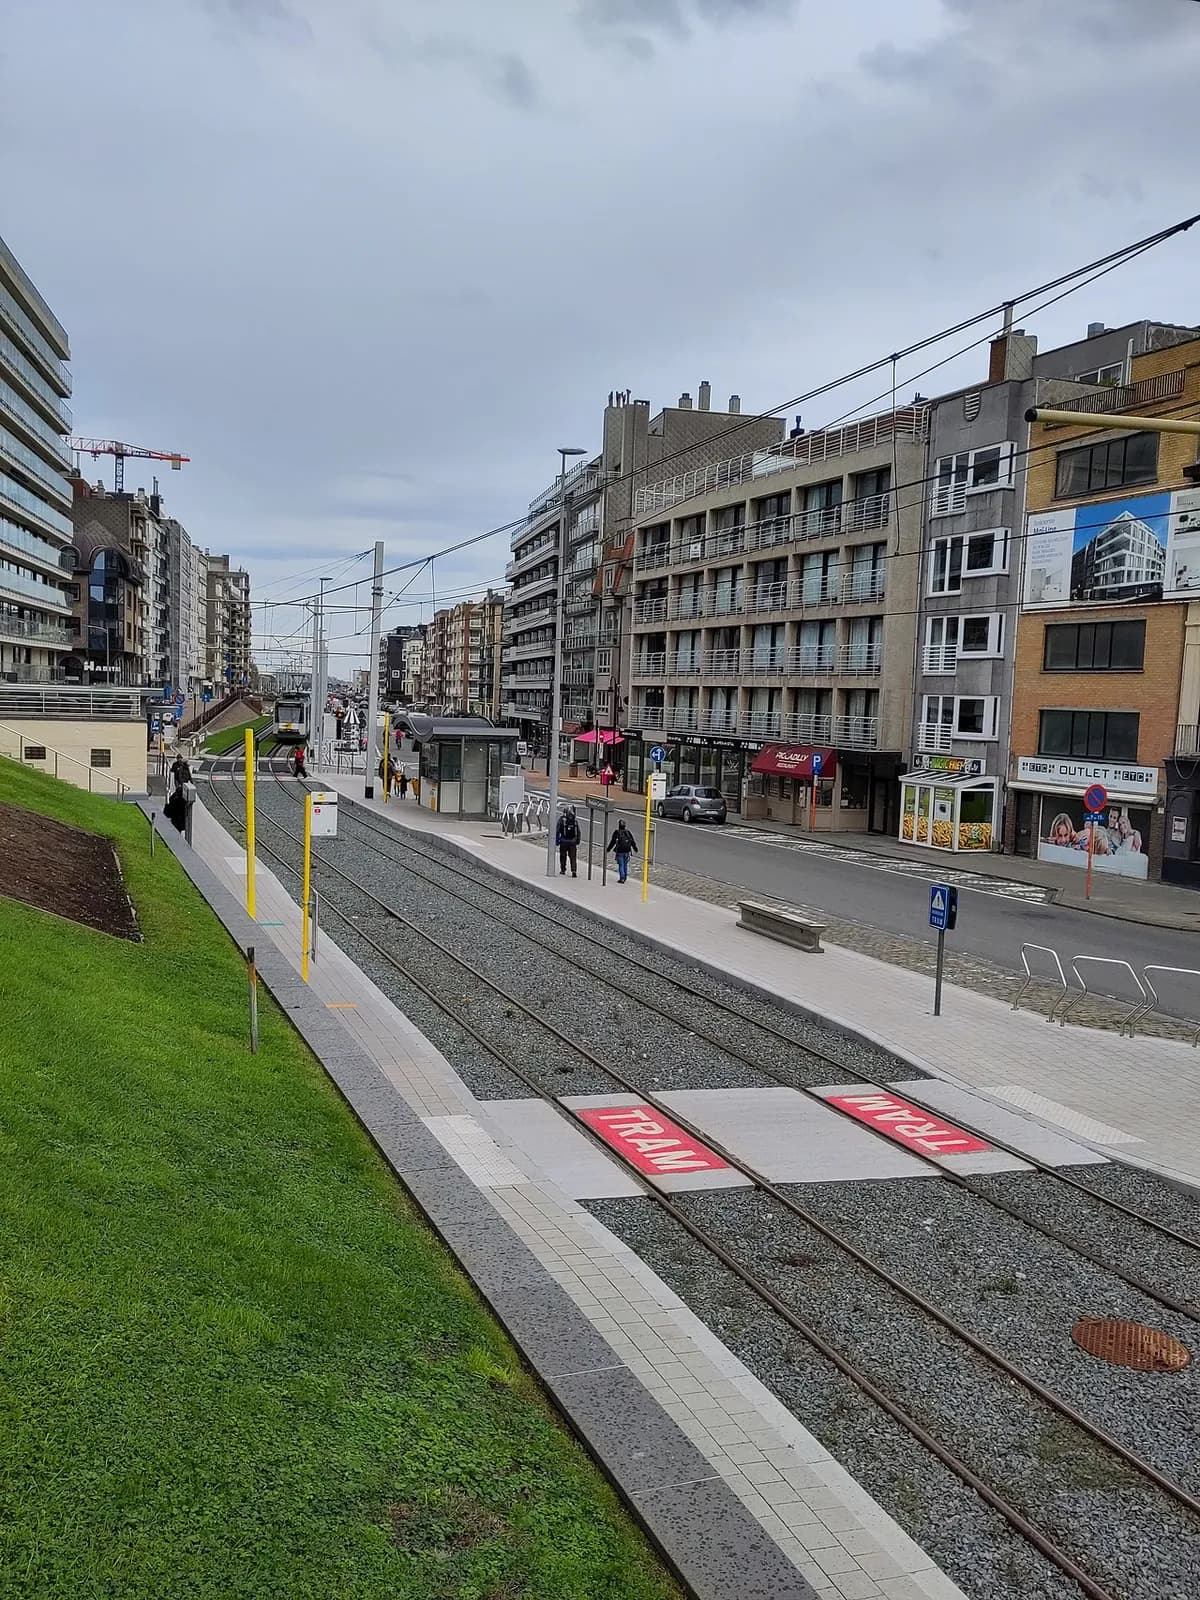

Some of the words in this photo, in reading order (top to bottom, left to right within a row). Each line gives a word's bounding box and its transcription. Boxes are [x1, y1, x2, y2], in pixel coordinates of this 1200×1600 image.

[813, 755, 821, 767] P
[1059, 765, 1110, 779] OUTLET
[598, 1110, 711, 1172] TRAM
[843, 1095, 967, 1152] TRAM
